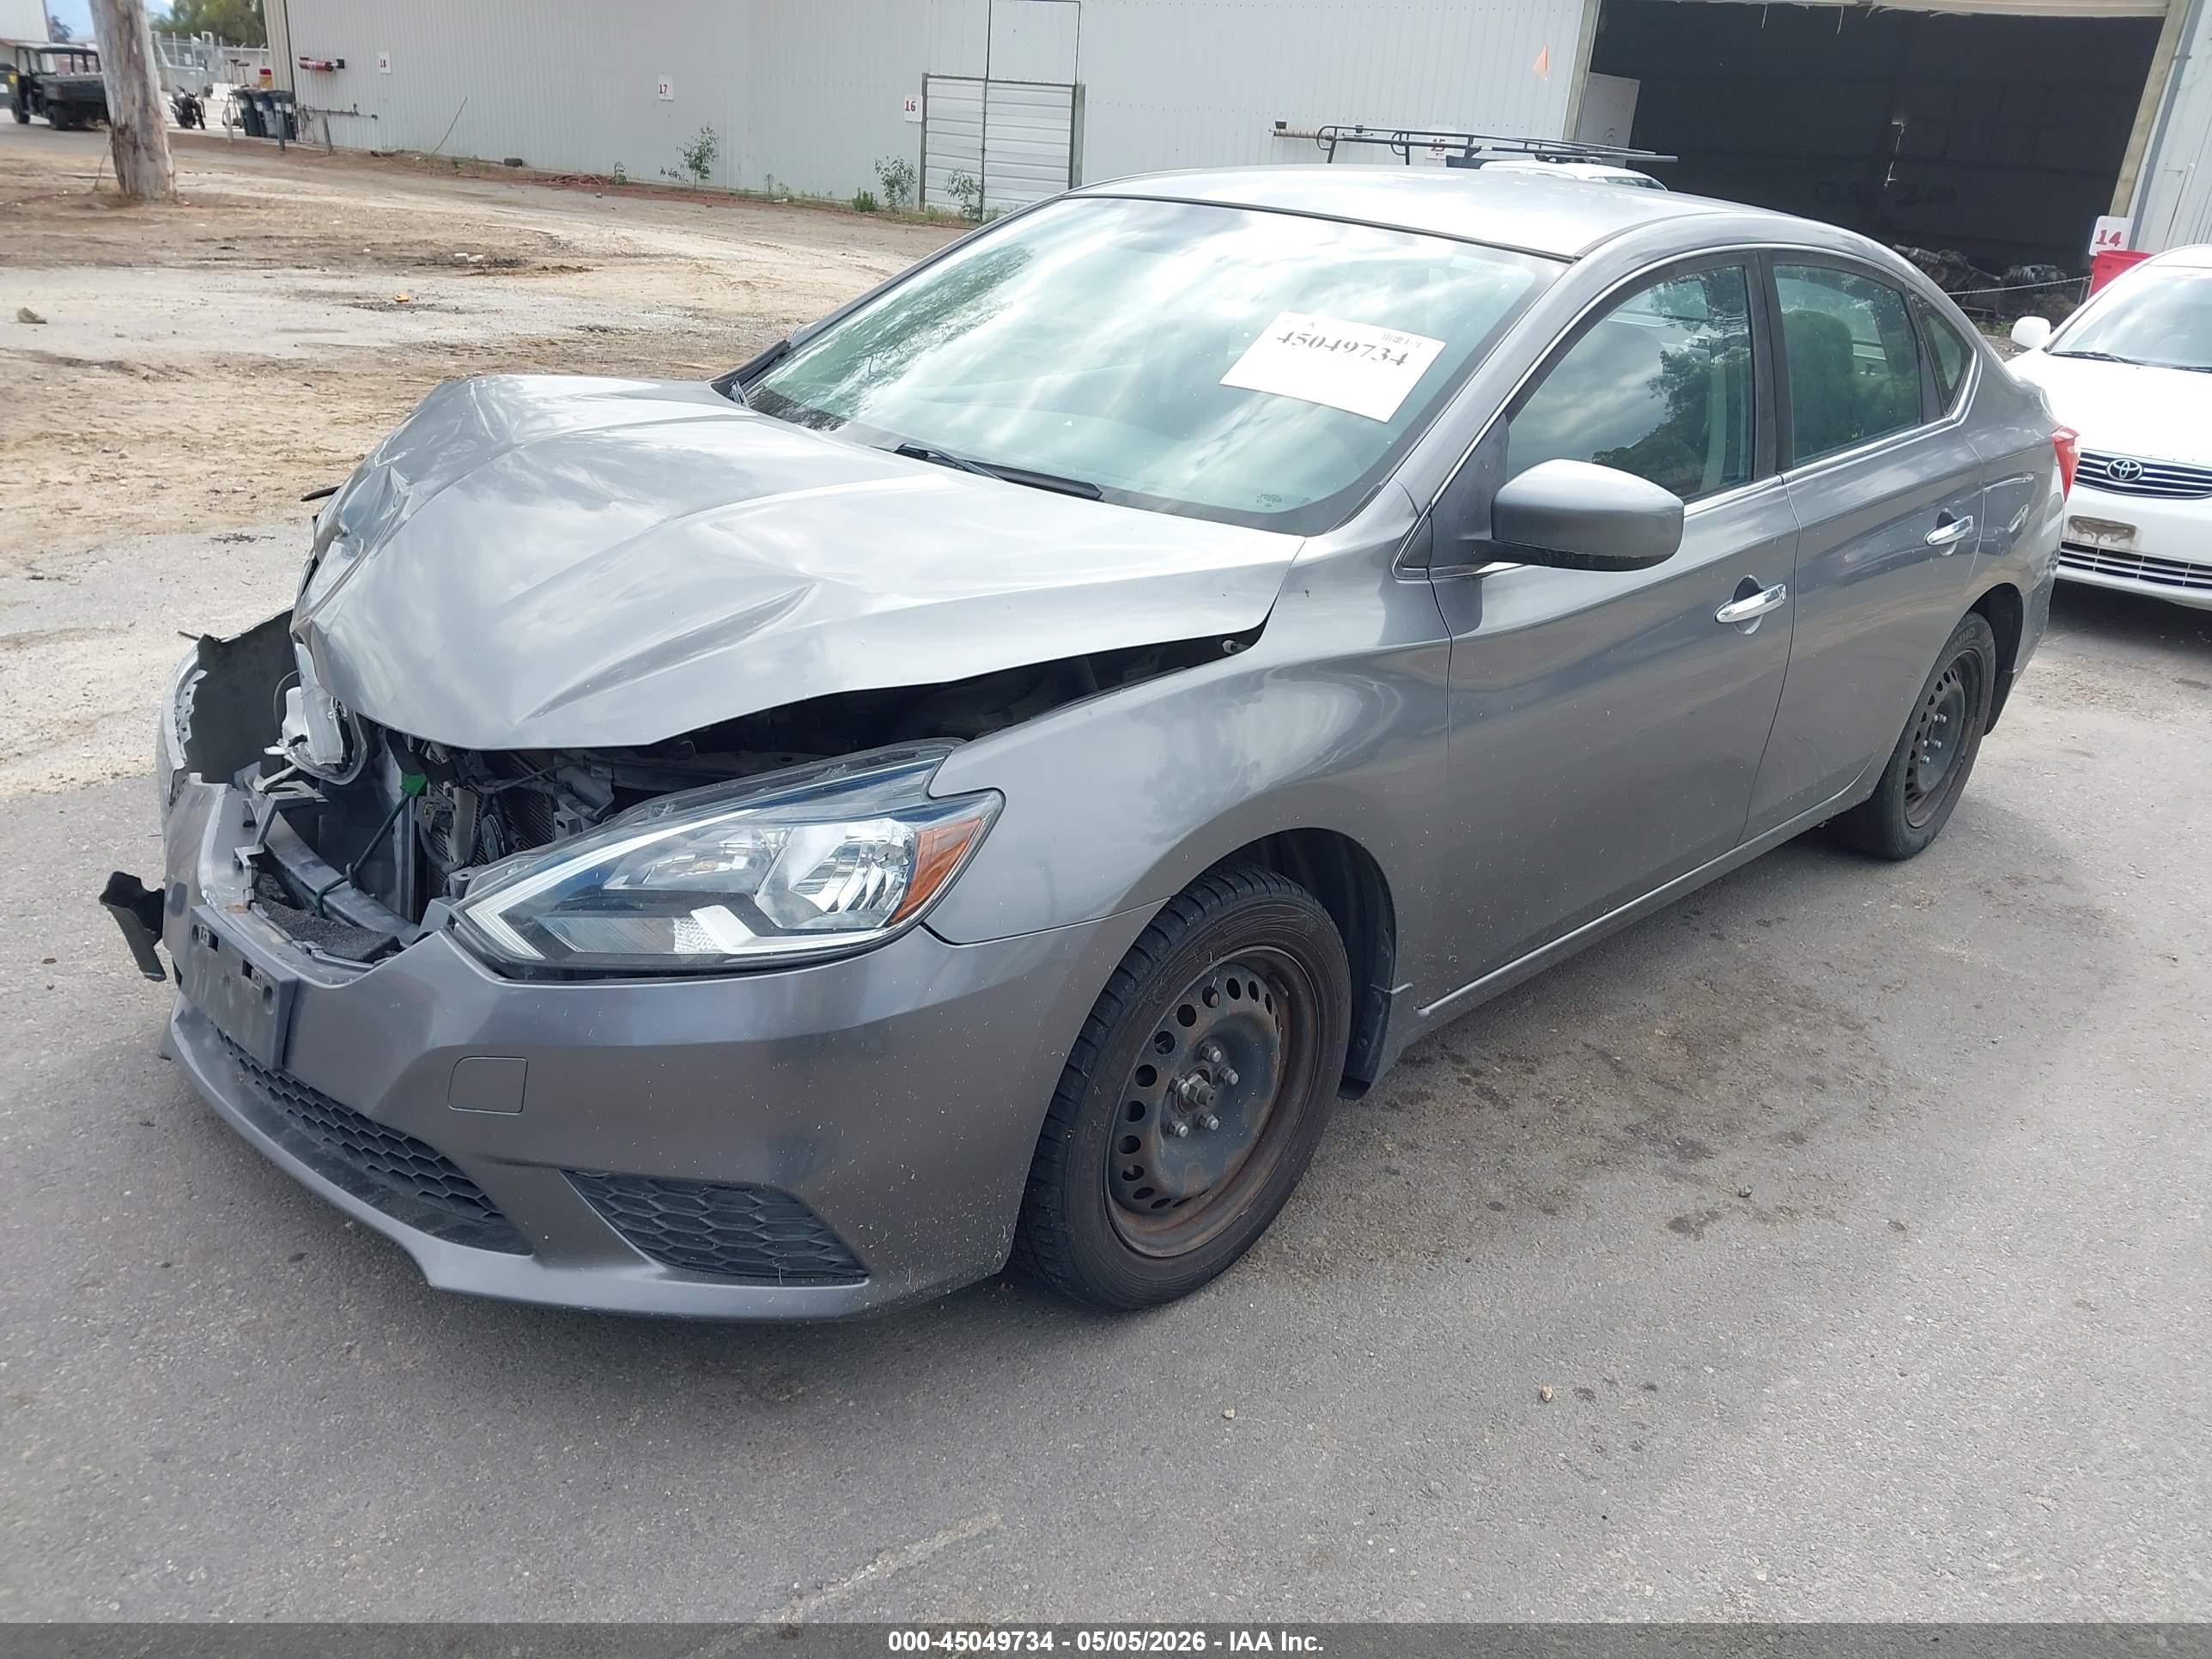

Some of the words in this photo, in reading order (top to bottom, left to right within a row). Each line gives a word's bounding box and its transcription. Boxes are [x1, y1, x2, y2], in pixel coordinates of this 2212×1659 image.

[659, 83, 667, 94] 17
[904, 100, 916, 112] 16
[2095, 229, 2122, 247] 14
[1276, 330, 1409, 367] 45049734
